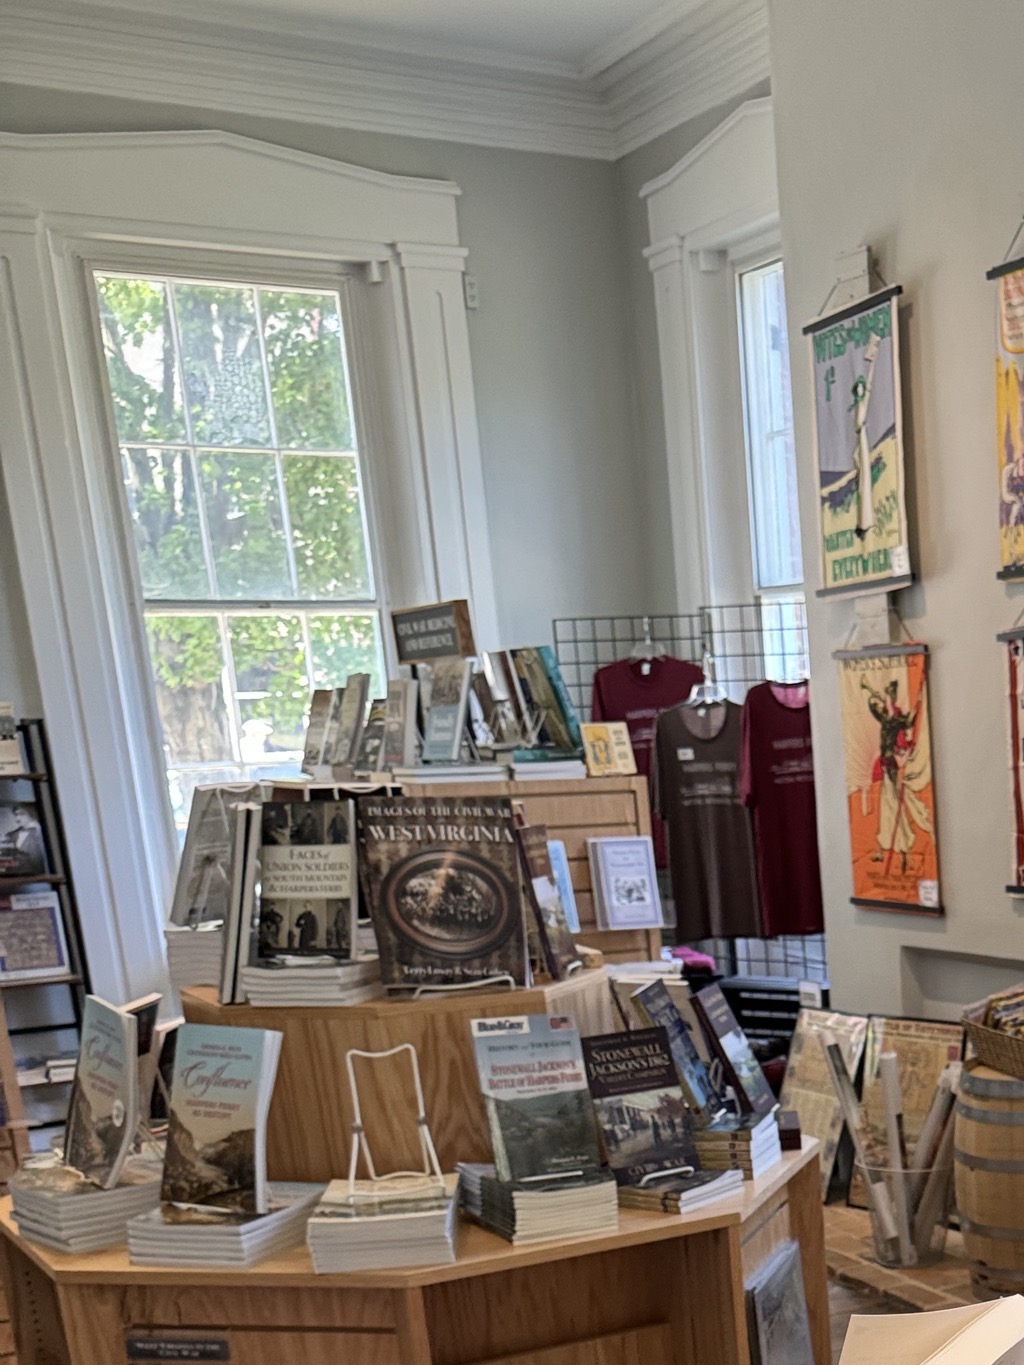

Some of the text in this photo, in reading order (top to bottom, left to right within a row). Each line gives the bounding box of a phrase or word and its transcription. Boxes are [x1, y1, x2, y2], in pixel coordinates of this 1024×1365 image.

[368, 825, 514, 844] WEST VIRGINIA
[591, 1043, 660, 1063] STONEWALL
